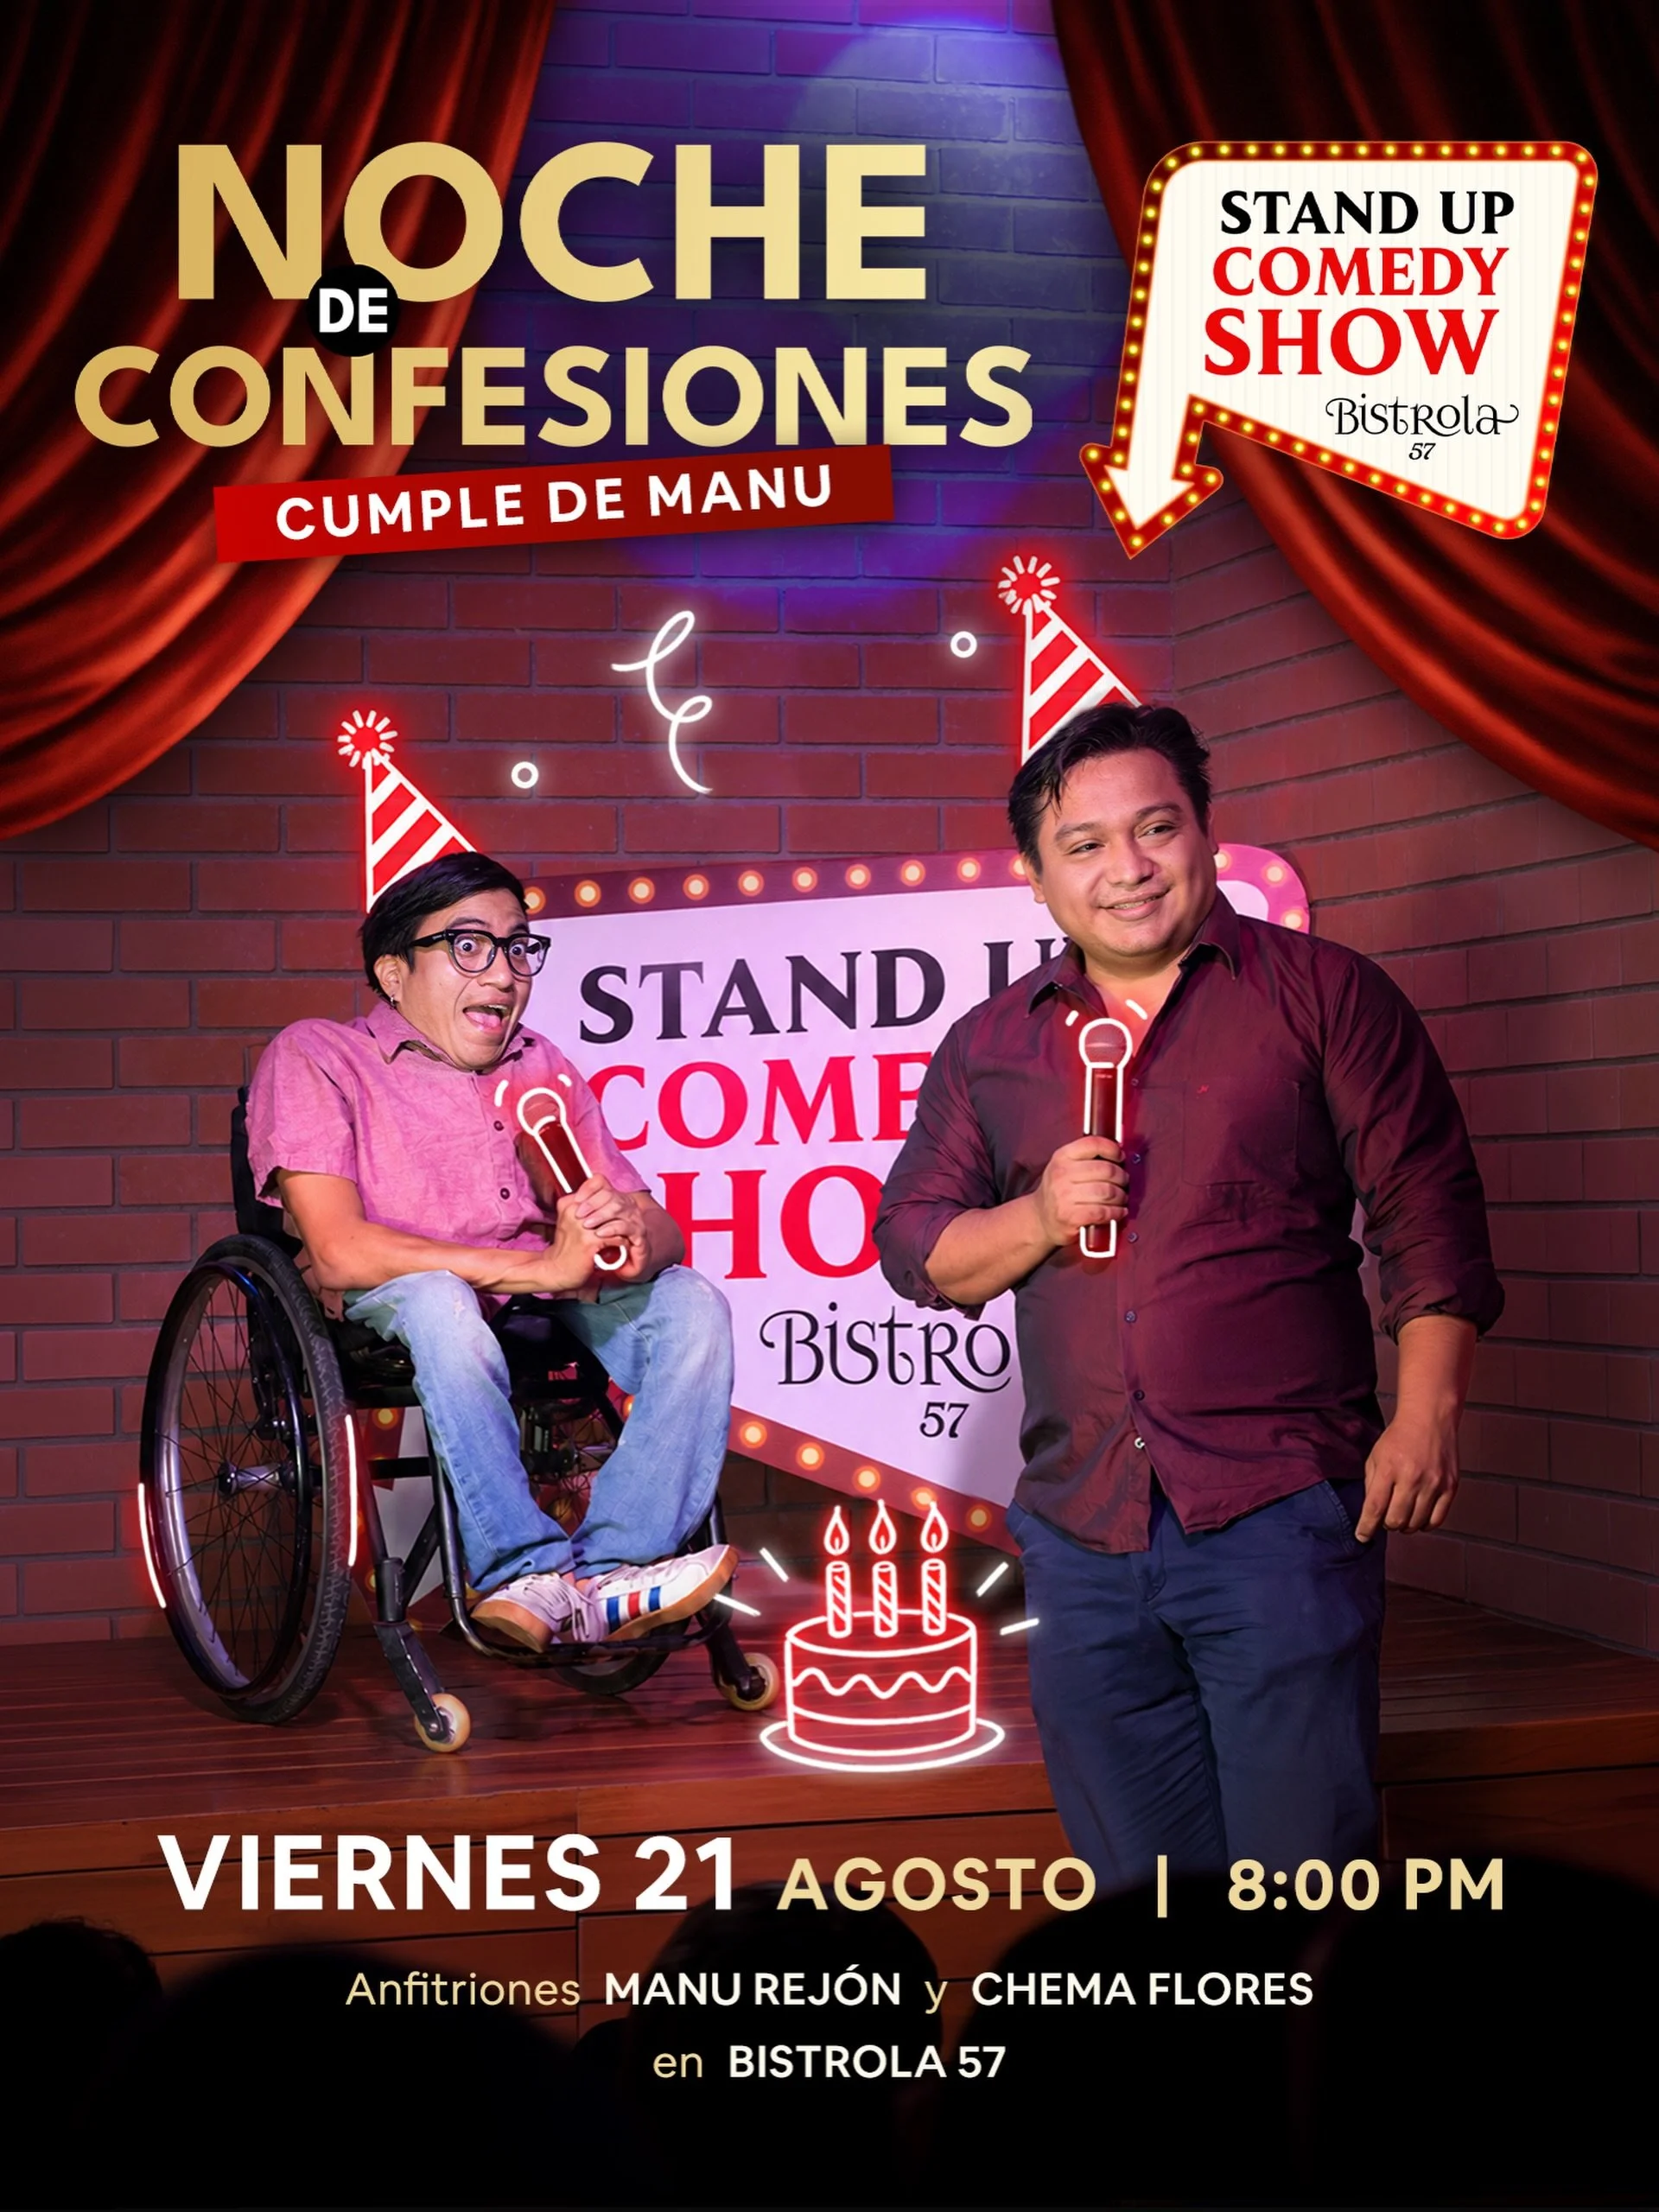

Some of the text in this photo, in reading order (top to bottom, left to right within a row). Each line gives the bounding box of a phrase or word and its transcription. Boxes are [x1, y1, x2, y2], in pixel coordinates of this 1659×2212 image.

[579, 948, 946, 1045] STAND
[588, 1051, 932, 1151] COME
[657, 1164, 885, 1281] HO
[918, 1401, 970, 1440] 57
